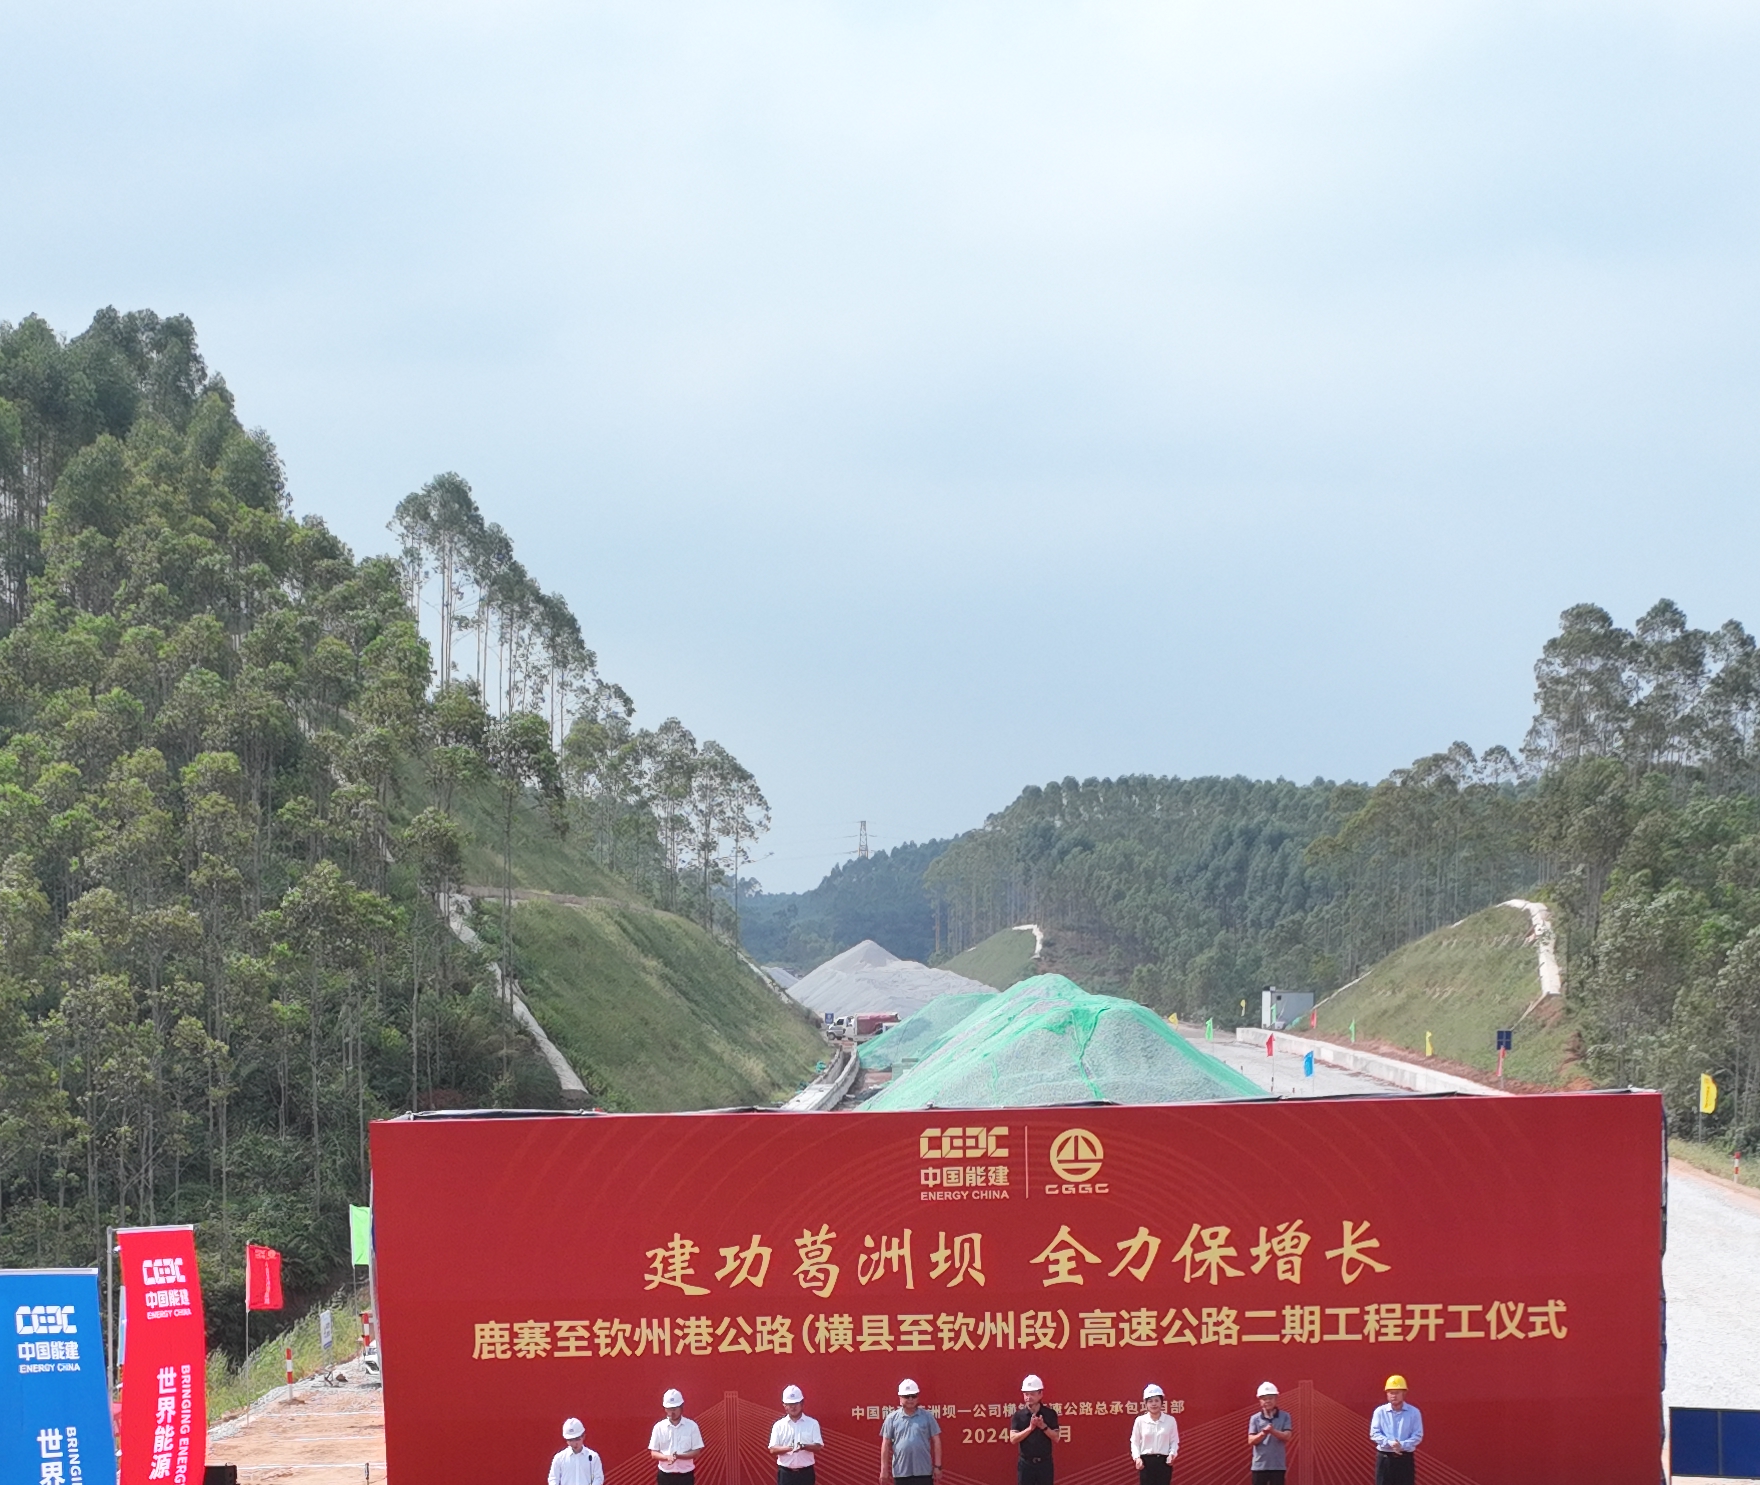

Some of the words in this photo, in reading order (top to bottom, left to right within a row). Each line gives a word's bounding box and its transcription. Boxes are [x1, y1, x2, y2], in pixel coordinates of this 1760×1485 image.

[920, 1165, 1010, 1188] 中国能建
[921, 1190, 969, 1201] ENERGY
[971, 1190, 1009, 1200] CHINA
[1045, 1183, 1109, 1194] CGGC
[643, 1224, 986, 1298] 建功葛洲坝
[1029, 1219, 1391, 1287] 全力保增长
[145, 1288, 190, 1308] 中国能建
[147, 1310, 172, 1319] ENERGY
[174, 1308, 192, 1316] CHINA
[17, 1341, 80, 1361] 中国能建
[19, 1363, 55, 1374] ENERGY
[56, 1363, 81, 1372] CHINA
[179, 1365, 190, 1435] BRINGING
[149, 1367, 177, 1480] 世界能源
